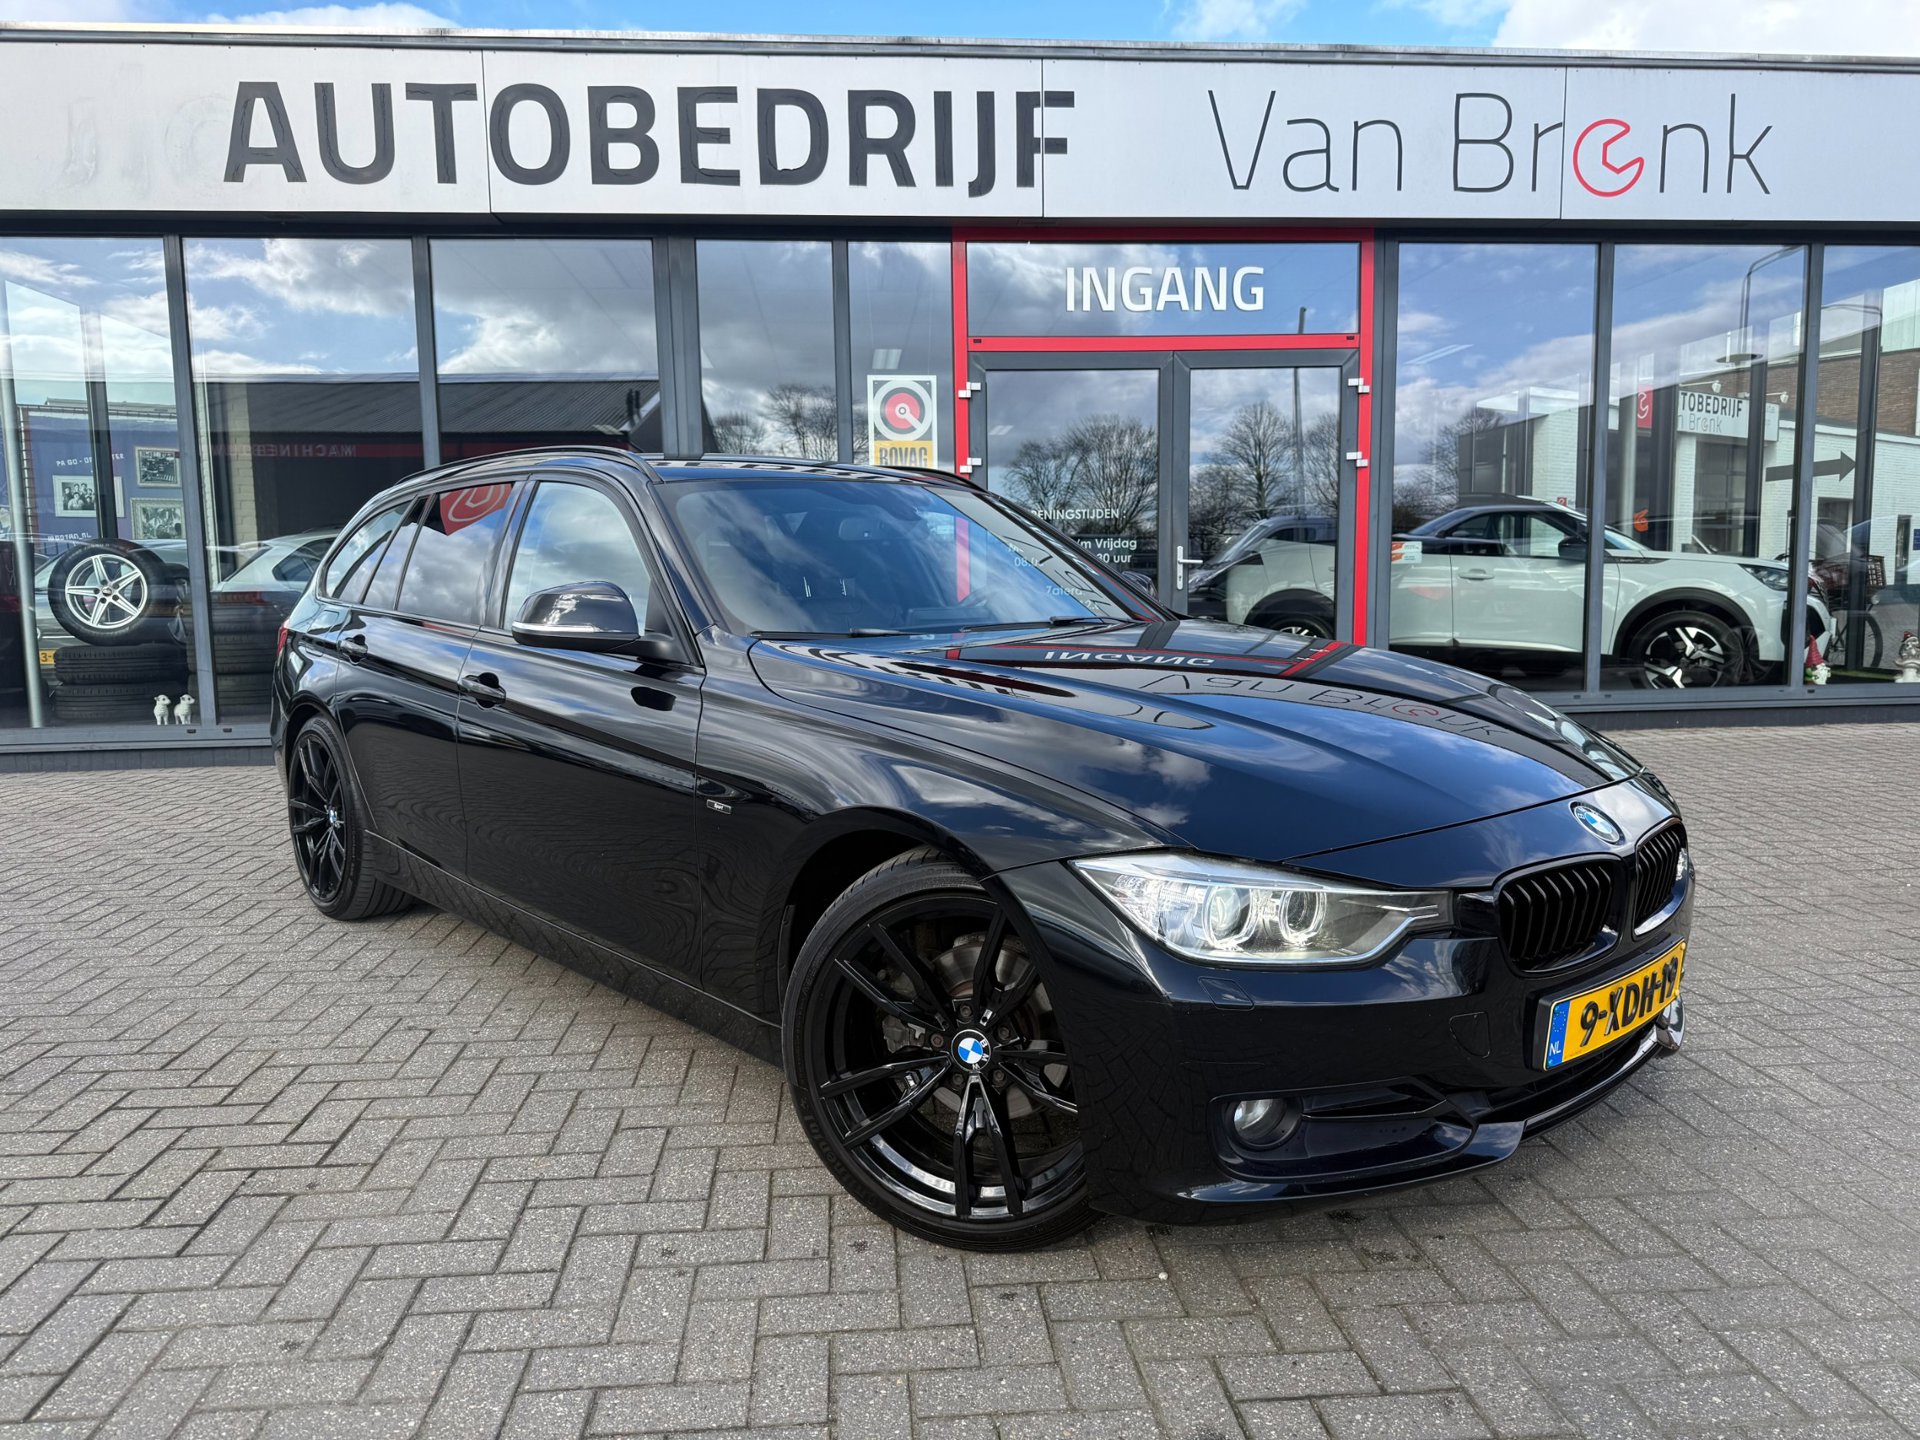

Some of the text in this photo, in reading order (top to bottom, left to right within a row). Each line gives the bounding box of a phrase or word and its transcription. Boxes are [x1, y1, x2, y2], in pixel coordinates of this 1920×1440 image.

[223, 81, 1075, 197] AUTOBEDRIJF
[1207, 89, 1402, 193] Van
[1066, 265, 1265, 313] INGANG
[1095, 538, 1137, 551] Vrijdag
[1113, 554, 1132, 563] uur
[1549, 1040, 1562, 1057] NL
